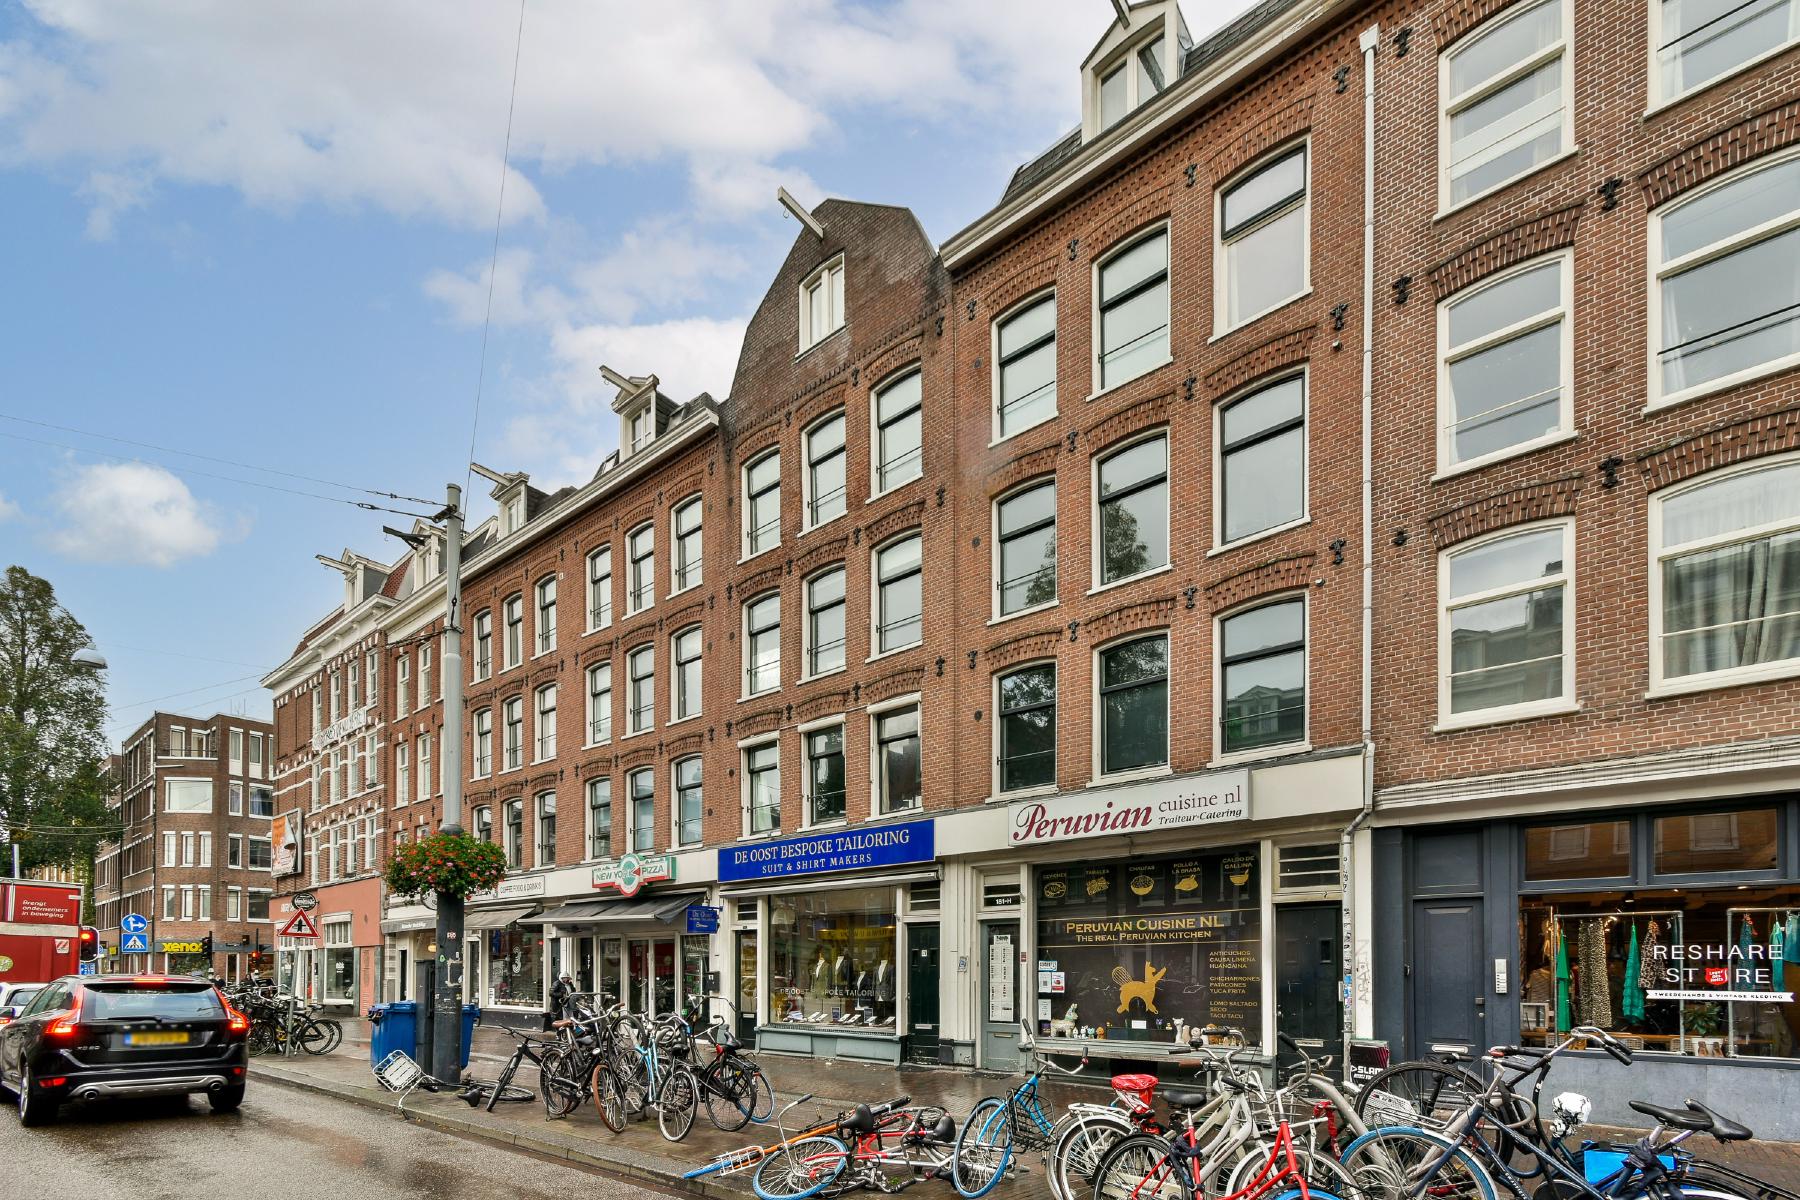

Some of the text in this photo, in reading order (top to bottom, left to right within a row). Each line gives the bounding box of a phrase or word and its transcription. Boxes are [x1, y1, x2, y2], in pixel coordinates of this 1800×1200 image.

[1012, 785, 1241, 841] Peruvian cuisine nl
[734, 829, 910, 864] DE OOST BESPOKE TAILORING
[762, 853, 872, 874] SUIT & SHIRT MAKERS
[596, 872, 612, 881] NEW
[642, 865, 664, 875] PIZZA
[1066, 916, 1225, 934] PERUVIAN CUISINE NL
[1095, 934, 1118, 942] REAL
[1168, 930, 1211, 939] KITCHEN
[1653, 944, 1784, 960] RESHARE
